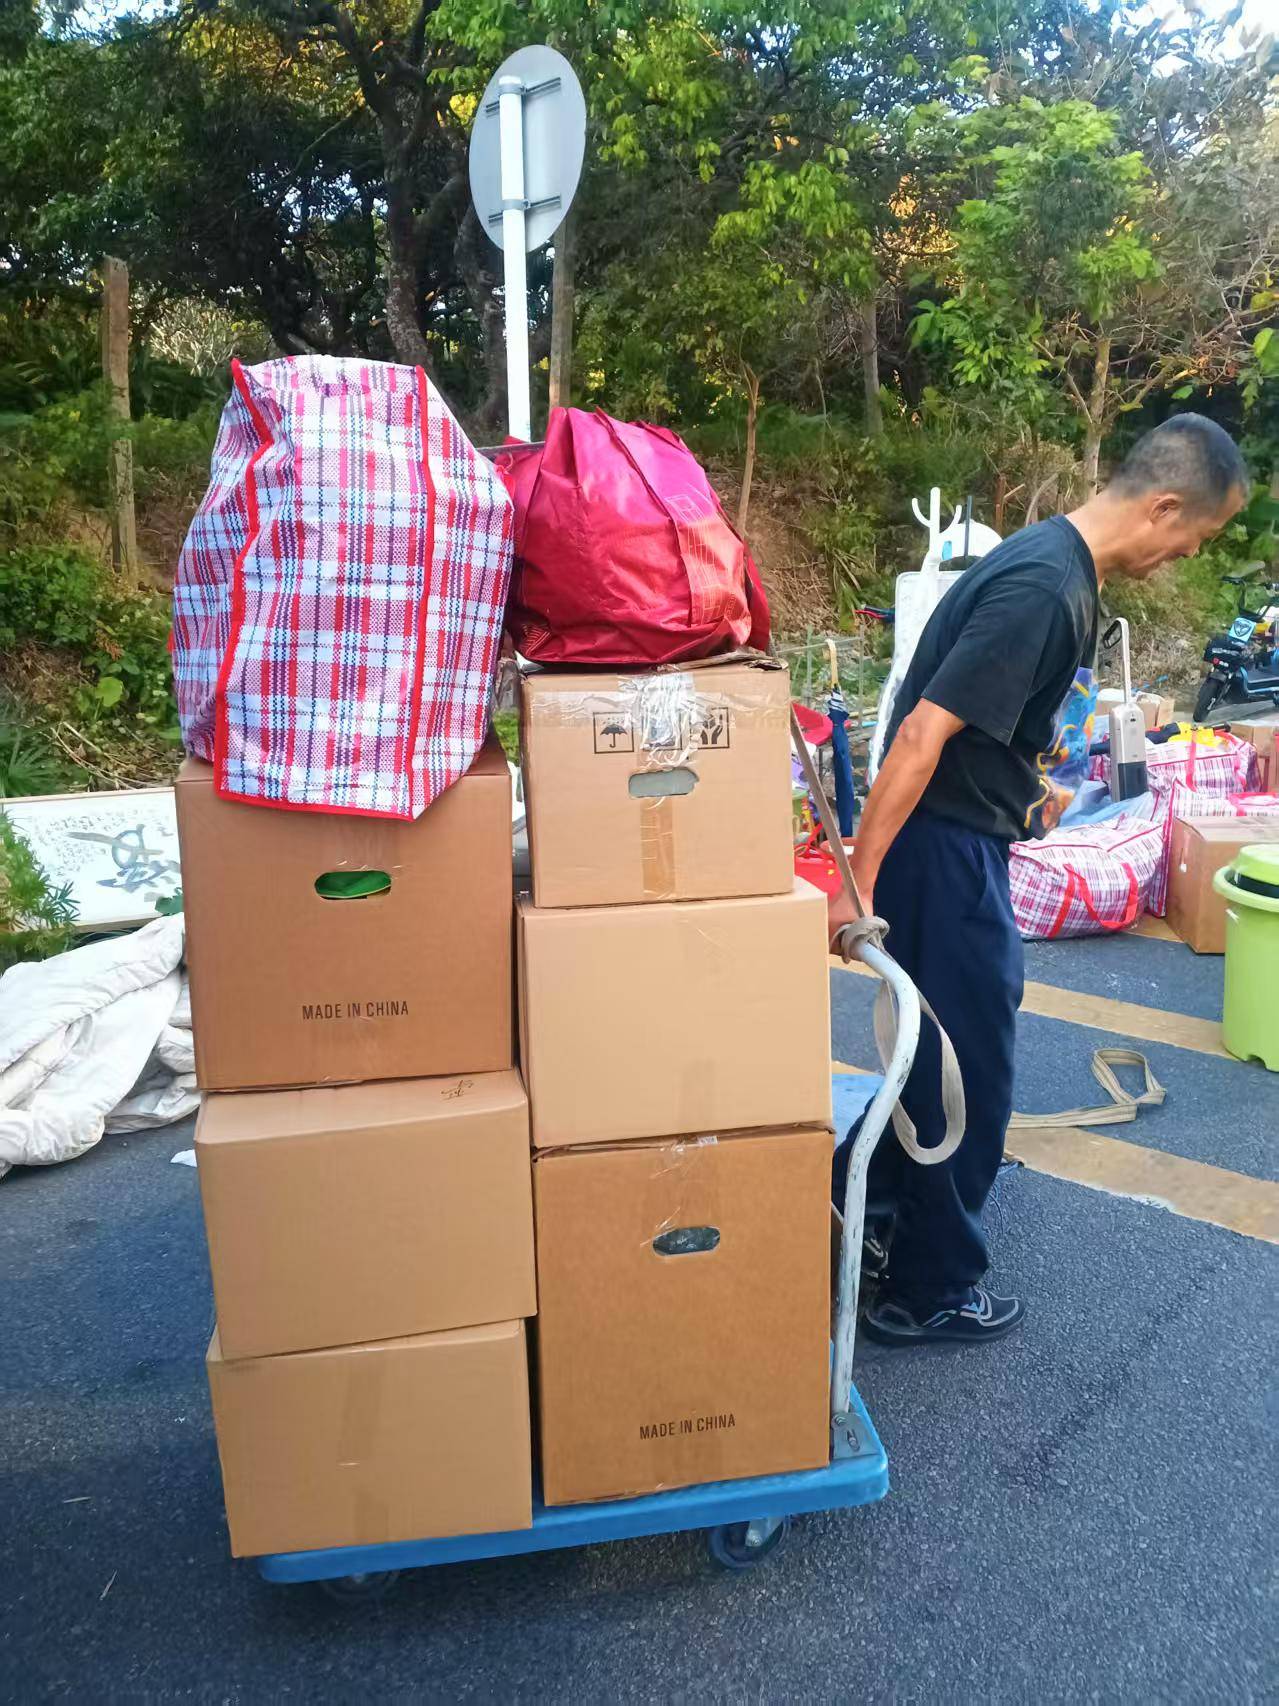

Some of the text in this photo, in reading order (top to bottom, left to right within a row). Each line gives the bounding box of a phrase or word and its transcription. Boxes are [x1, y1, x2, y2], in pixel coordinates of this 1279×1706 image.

[302, 1000, 409, 1020] MADE IN CHINA
[639, 1413, 736, 1440] MADE IN CHINA
